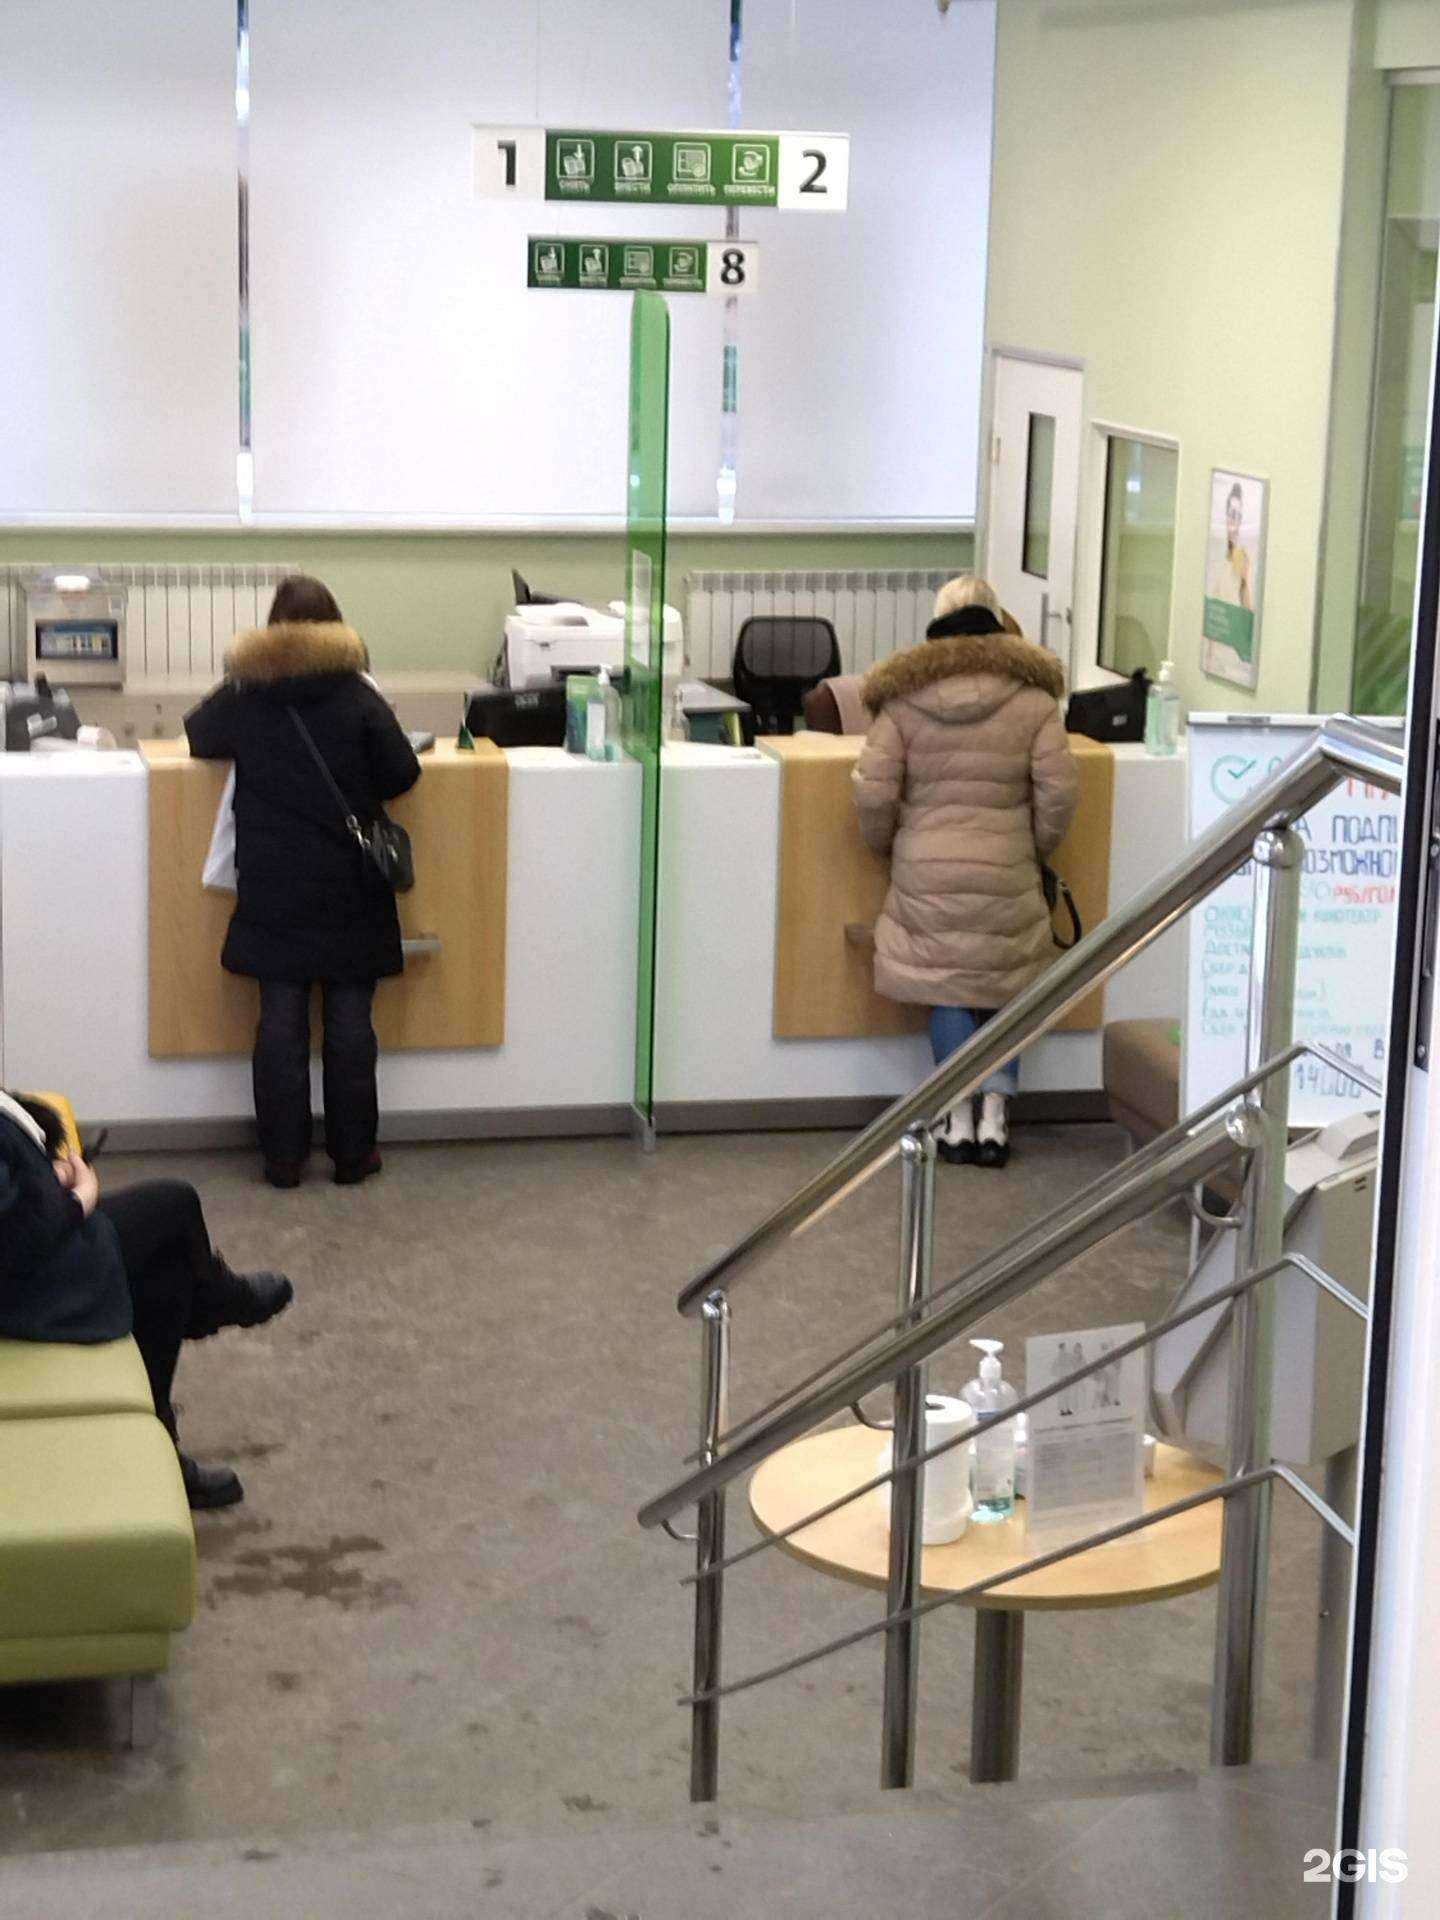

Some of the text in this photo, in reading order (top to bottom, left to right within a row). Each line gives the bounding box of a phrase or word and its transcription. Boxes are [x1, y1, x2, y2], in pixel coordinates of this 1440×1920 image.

[497, 140, 516, 186] 1
[799, 149, 828, 193] 2
[720, 248, 745, 285] 8
[1302, 848, 1397, 878] ОЗМОЖНО
